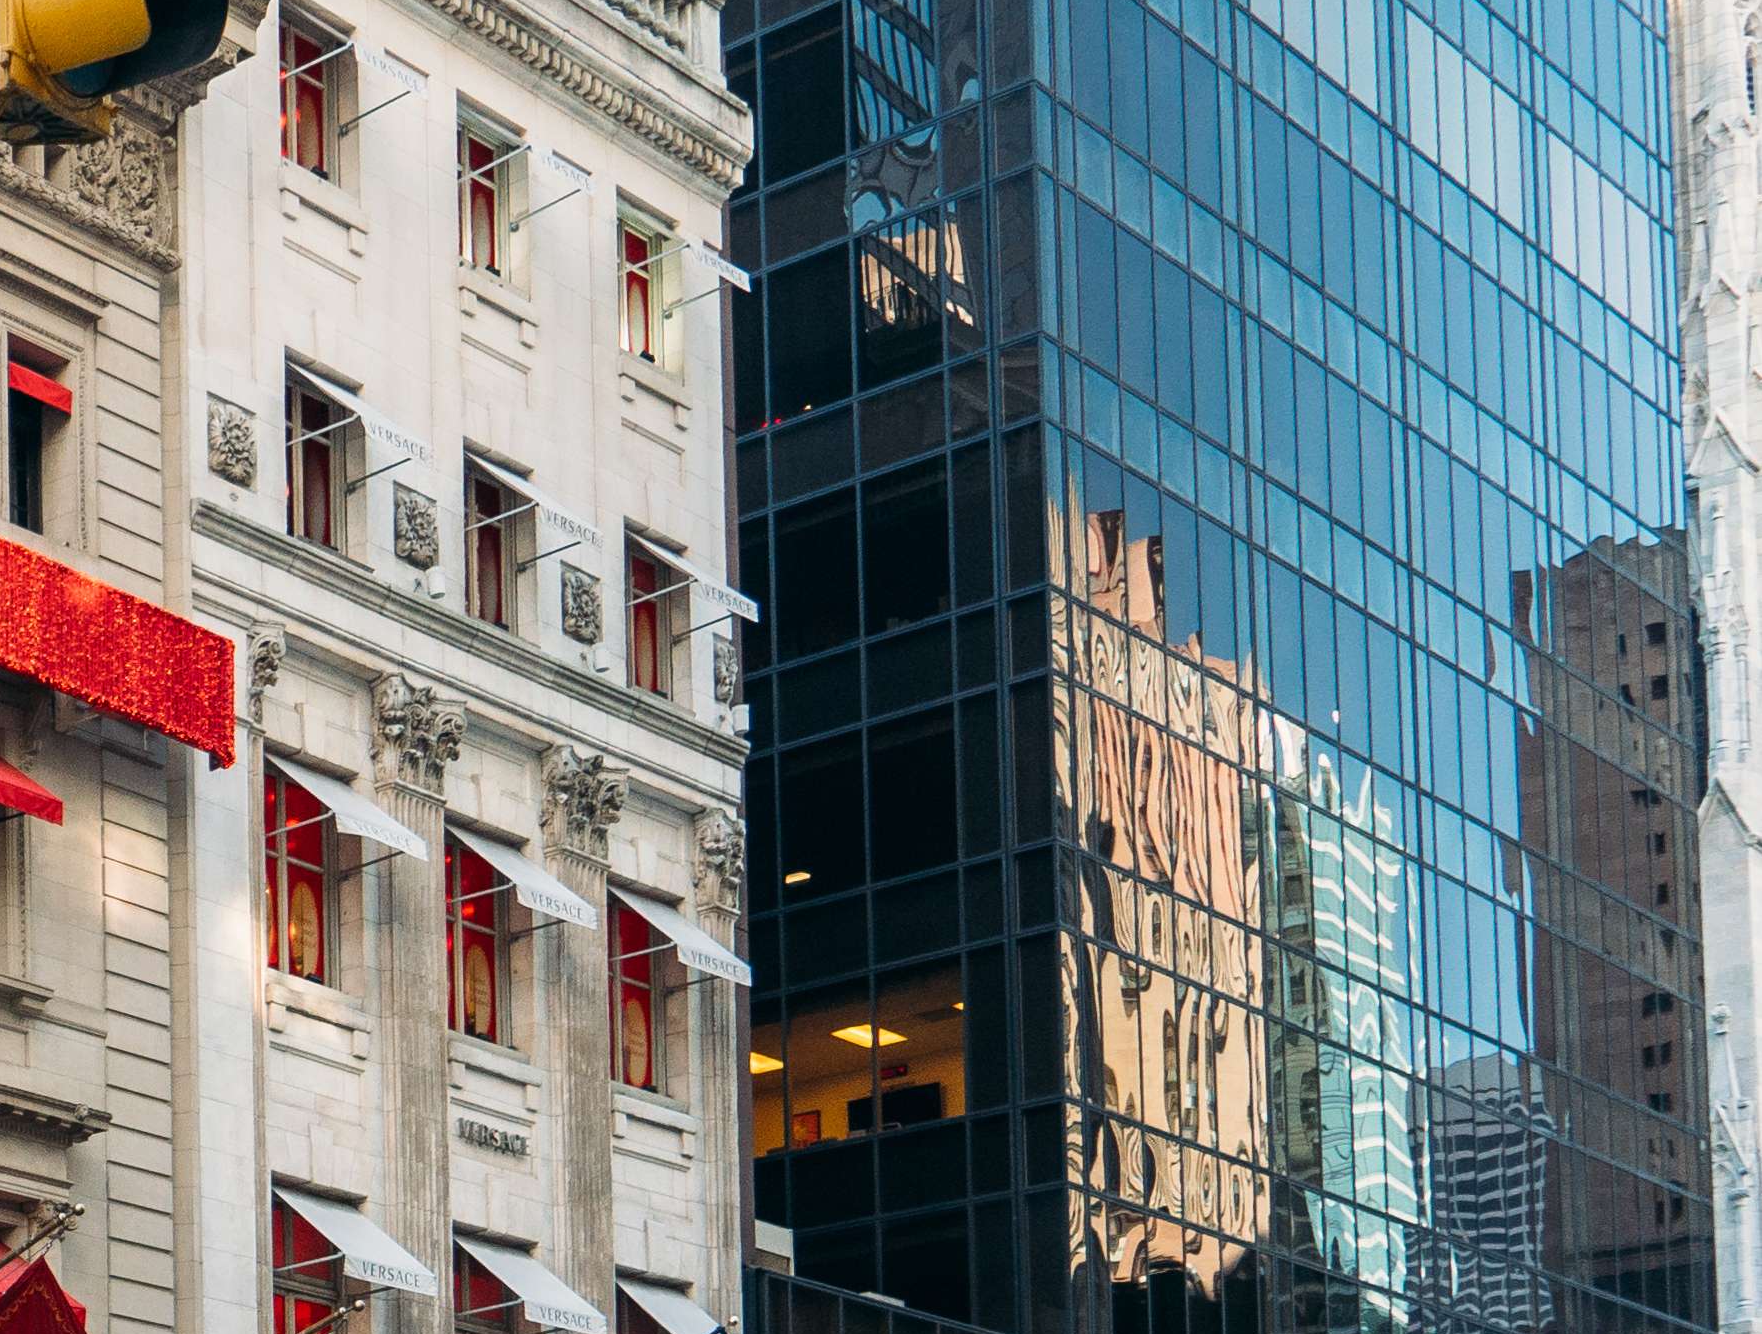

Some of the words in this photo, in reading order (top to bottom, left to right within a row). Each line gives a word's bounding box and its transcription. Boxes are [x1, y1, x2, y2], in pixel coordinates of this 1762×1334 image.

[368, 421, 427, 461] VERSACE
[544, 508, 600, 547] VERSACE
[702, 583, 755, 618] VERSACE
[352, 817, 413, 851] VERSACE
[530, 890, 583, 921] VERSACE
[689, 949, 740, 976] VERSACE
[457, 1117, 531, 1157] VERSACE
[360, 1258, 421, 1289] VERSACE
[539, 1304, 592, 1331] VERSACE
